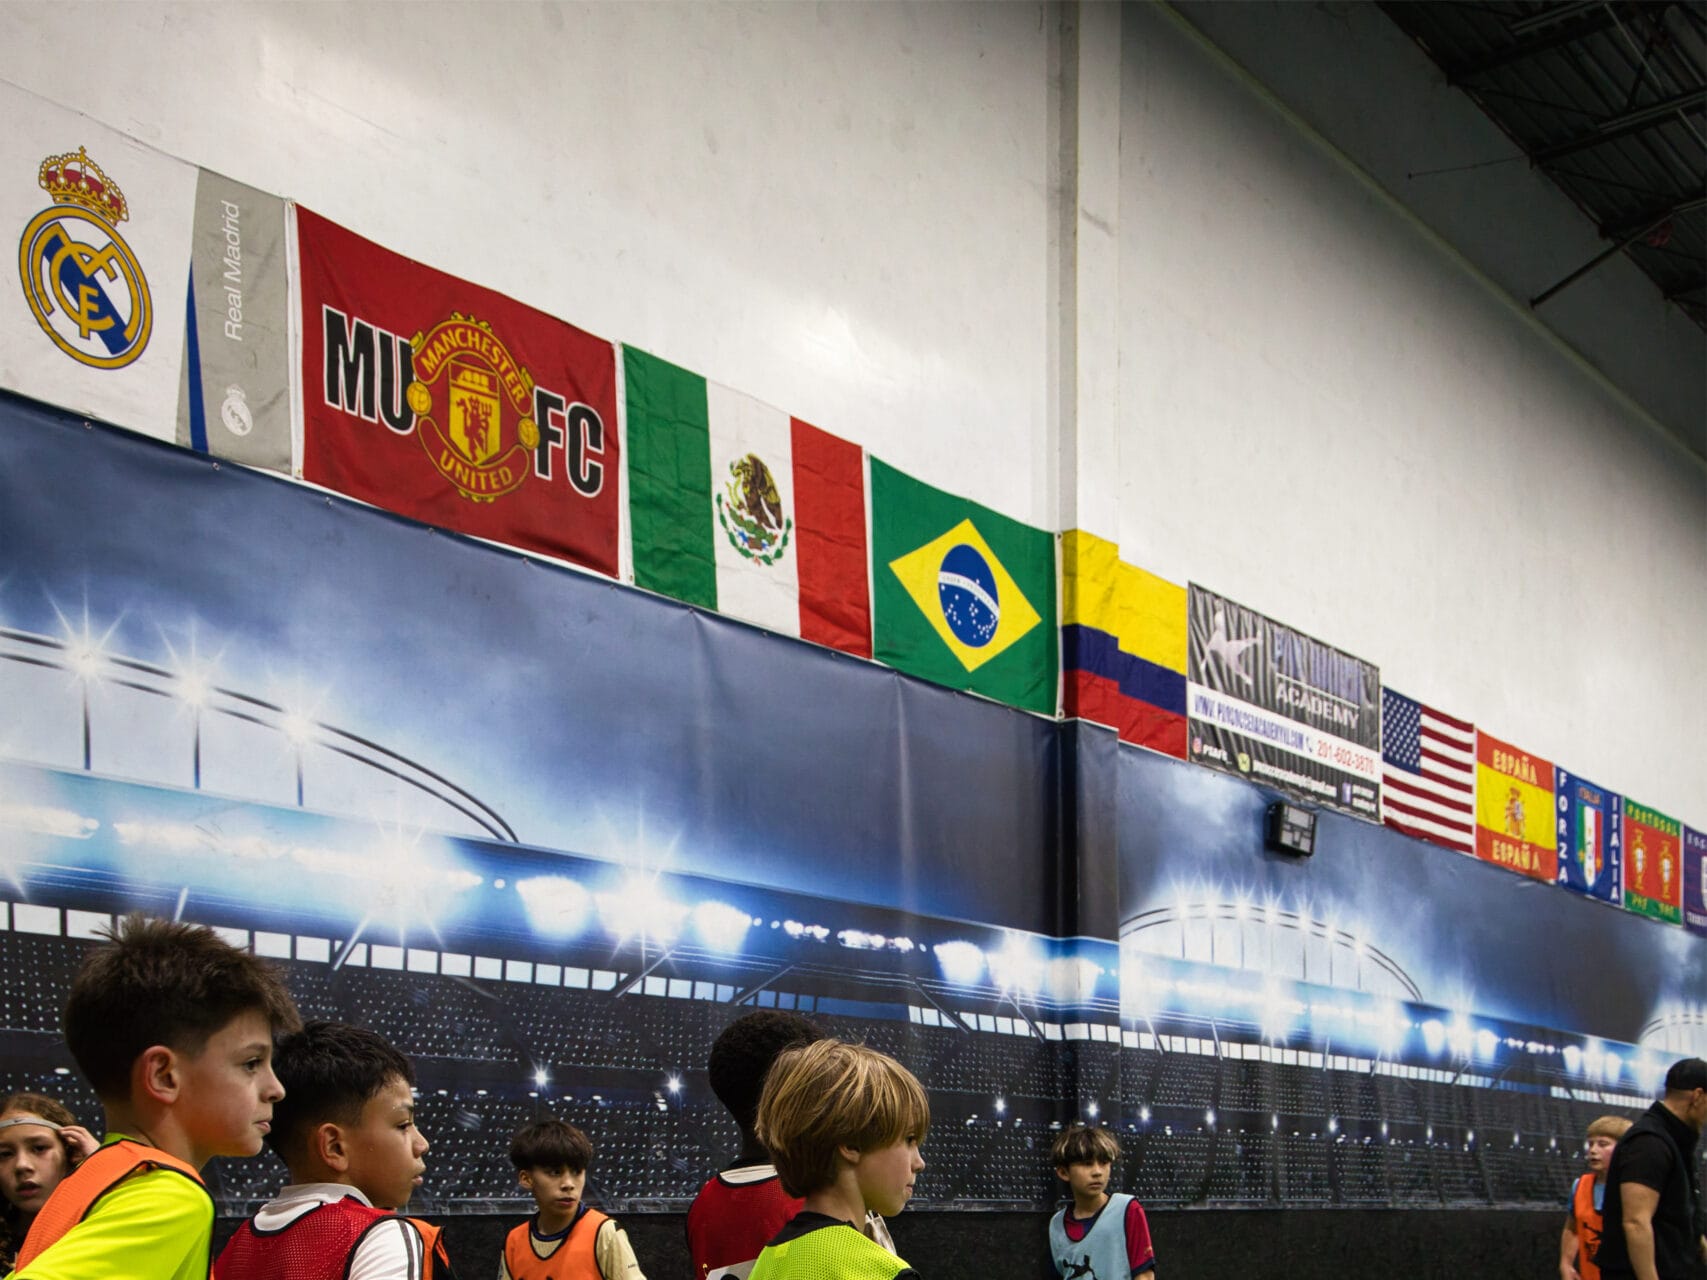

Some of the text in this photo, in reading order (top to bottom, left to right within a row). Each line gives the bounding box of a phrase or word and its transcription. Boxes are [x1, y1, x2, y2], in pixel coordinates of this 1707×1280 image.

[220, 200, 243, 342] Real Madrid
[420, 327, 526, 403] MANCHESTER
[323, 305, 606, 498] MU FC
[440, 448, 513, 491] UNITED
[1275, 683, 1359, 729] ACADEMY
[1492, 748, 1538, 785] ESPAÑA
[1558, 772, 1568, 884] FORZA
[1610, 796, 1619, 900] ITALIA
[1627, 804, 1678, 836] PORTUGAL
[1492, 838, 1541, 872] ESPAÑA
